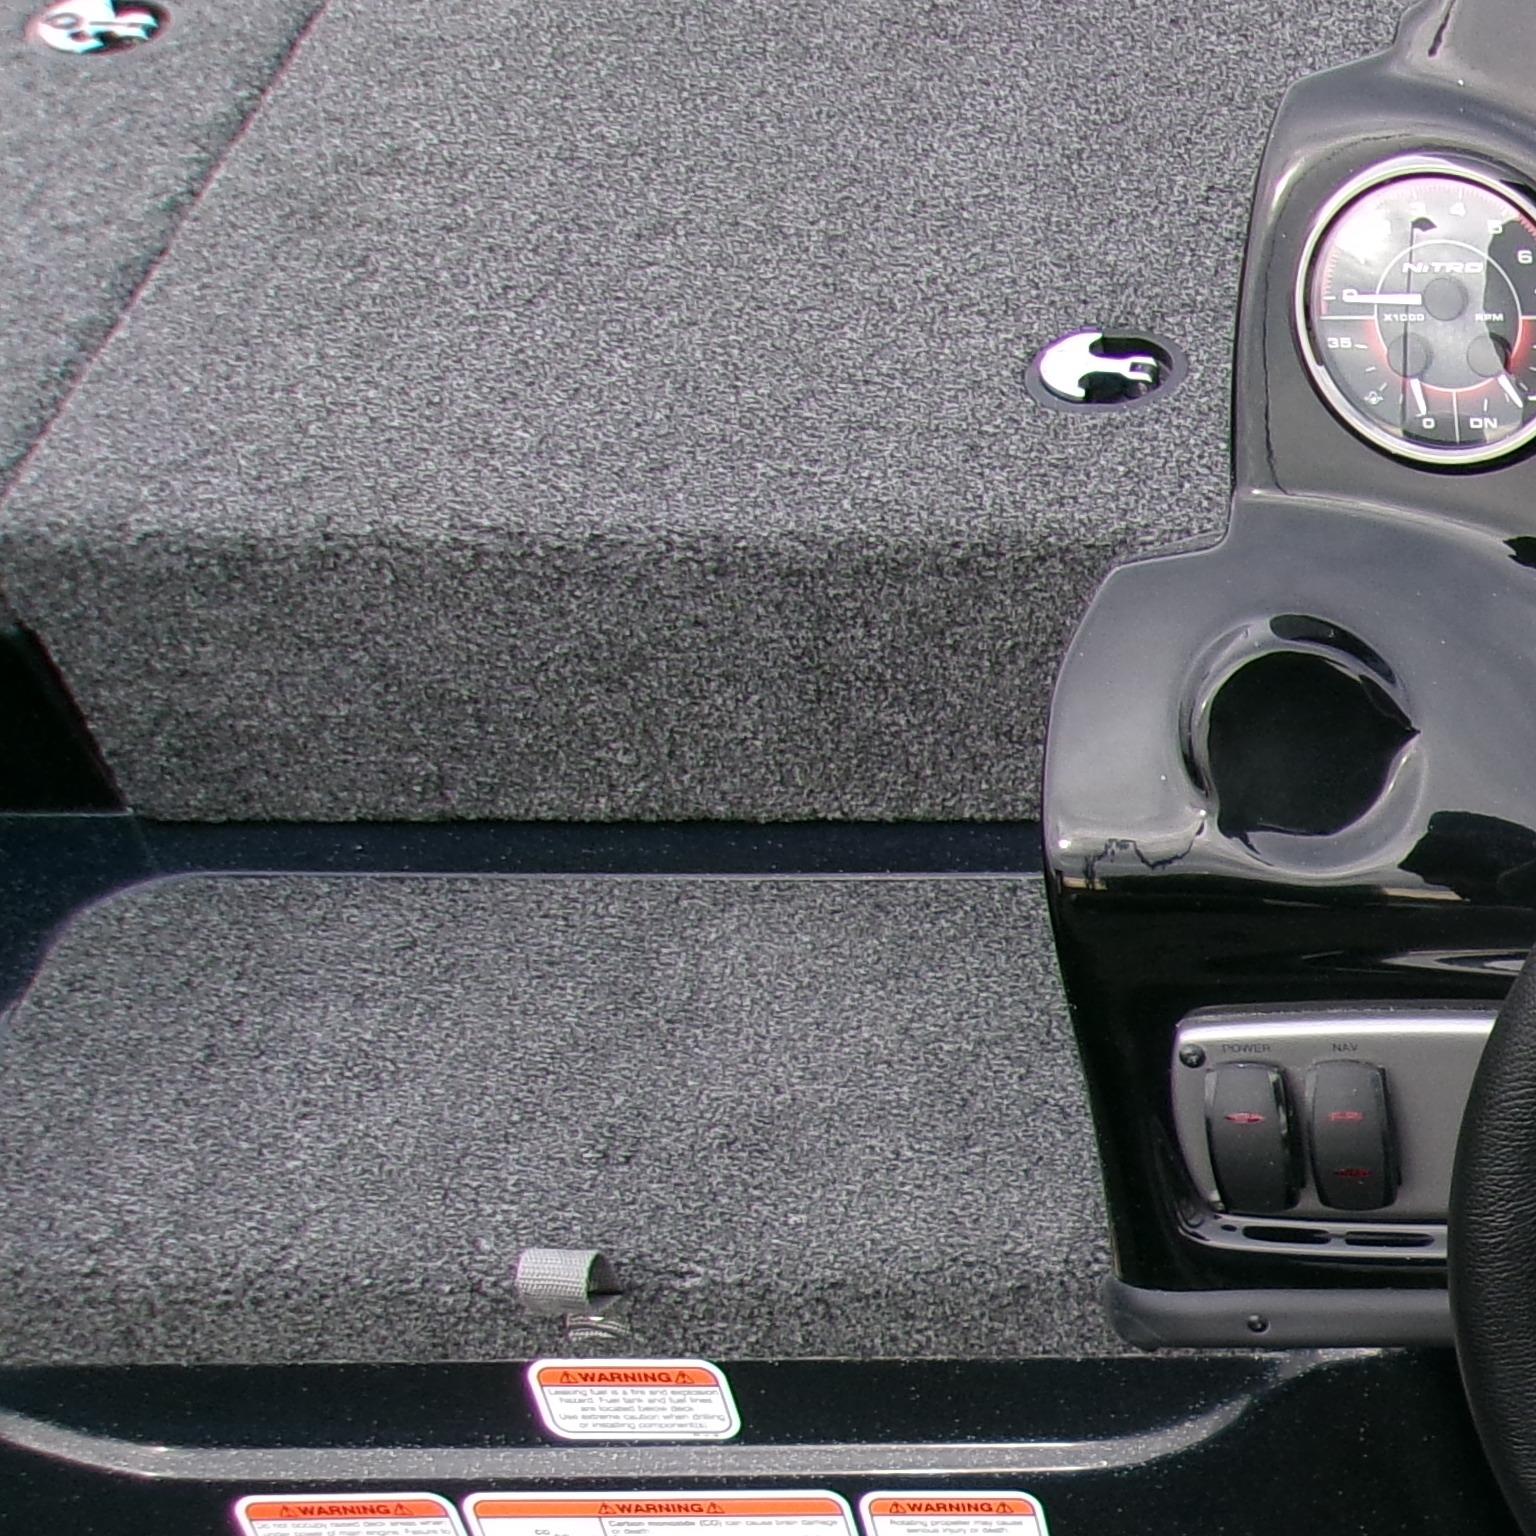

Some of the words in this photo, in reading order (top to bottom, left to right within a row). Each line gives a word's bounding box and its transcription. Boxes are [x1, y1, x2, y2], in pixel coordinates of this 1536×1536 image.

[1517, 251, 1532, 263] 6
[1475, 313, 1504, 322] RPM
[1422, 418, 1435, 429] 0
[1469, 418, 1498, 429] DN
[1332, 1042, 1359, 1053] NAV
[579, 1372, 672, 1383] WARNING
[298, 1504, 390, 1516] WARNING
[617, 1503, 704, 1513] WARNING
[907, 1503, 993, 1512] WARNING
